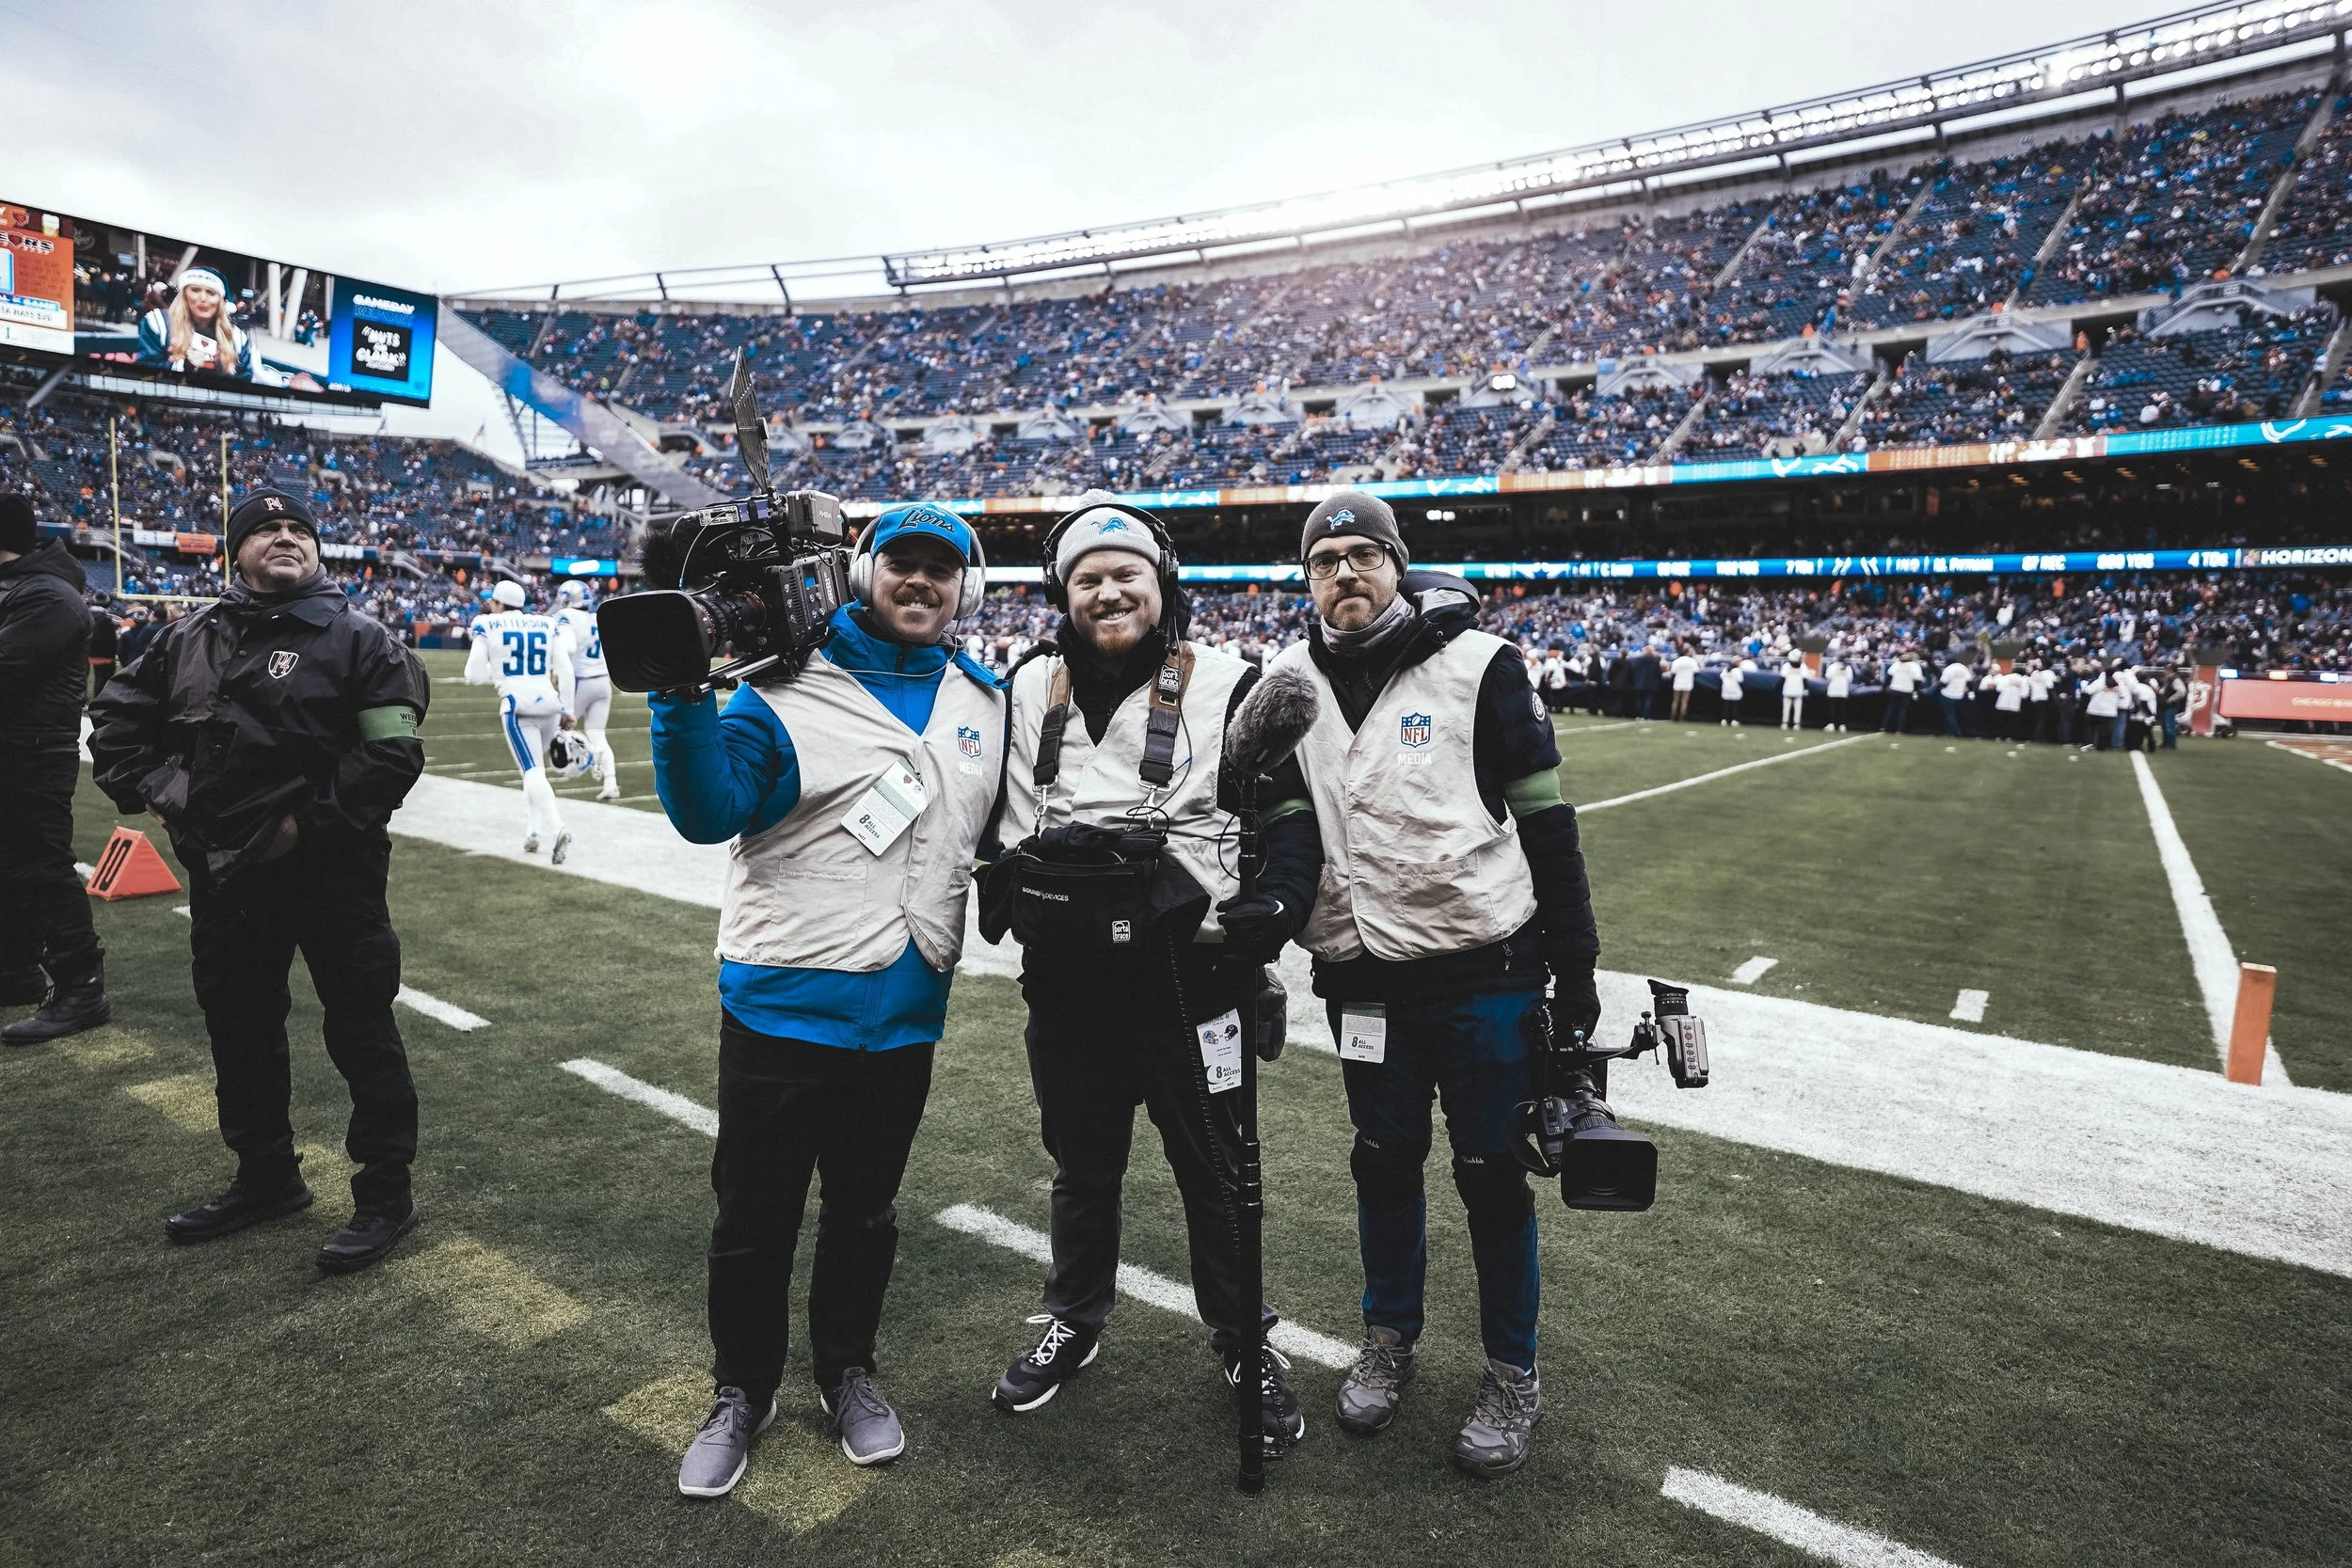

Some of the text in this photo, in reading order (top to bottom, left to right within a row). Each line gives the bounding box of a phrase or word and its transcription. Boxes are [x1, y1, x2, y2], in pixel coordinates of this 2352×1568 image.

[353, 294, 415, 315] GAMEDAY
[897, 509, 955, 533] Lions
[2187, 552, 2199, 567] 4
[2260, 548, 2352, 564] HORIZON
[824, 577, 835, 605] ARRI
[489, 620, 549, 629] PATTERSON
[502, 631, 547, 676] 36
[1404, 727, 1427, 743] NFL
[961, 739, 979, 754] NFL
[1398, 752, 1432, 766] MEDIA
[959, 761, 983, 777] MEDIA
[858, 814, 876, 829] 8 ALL
[865, 824, 880, 839] ACCESS
[92, 837, 133, 891] 10
[1022, 887, 1069, 901] SOUND DEVICES
[1351, 1036, 1359, 1048] 8
[1216, 1066, 1223, 1079] 8
[1223, 1068, 1241, 1078] ACCESS
